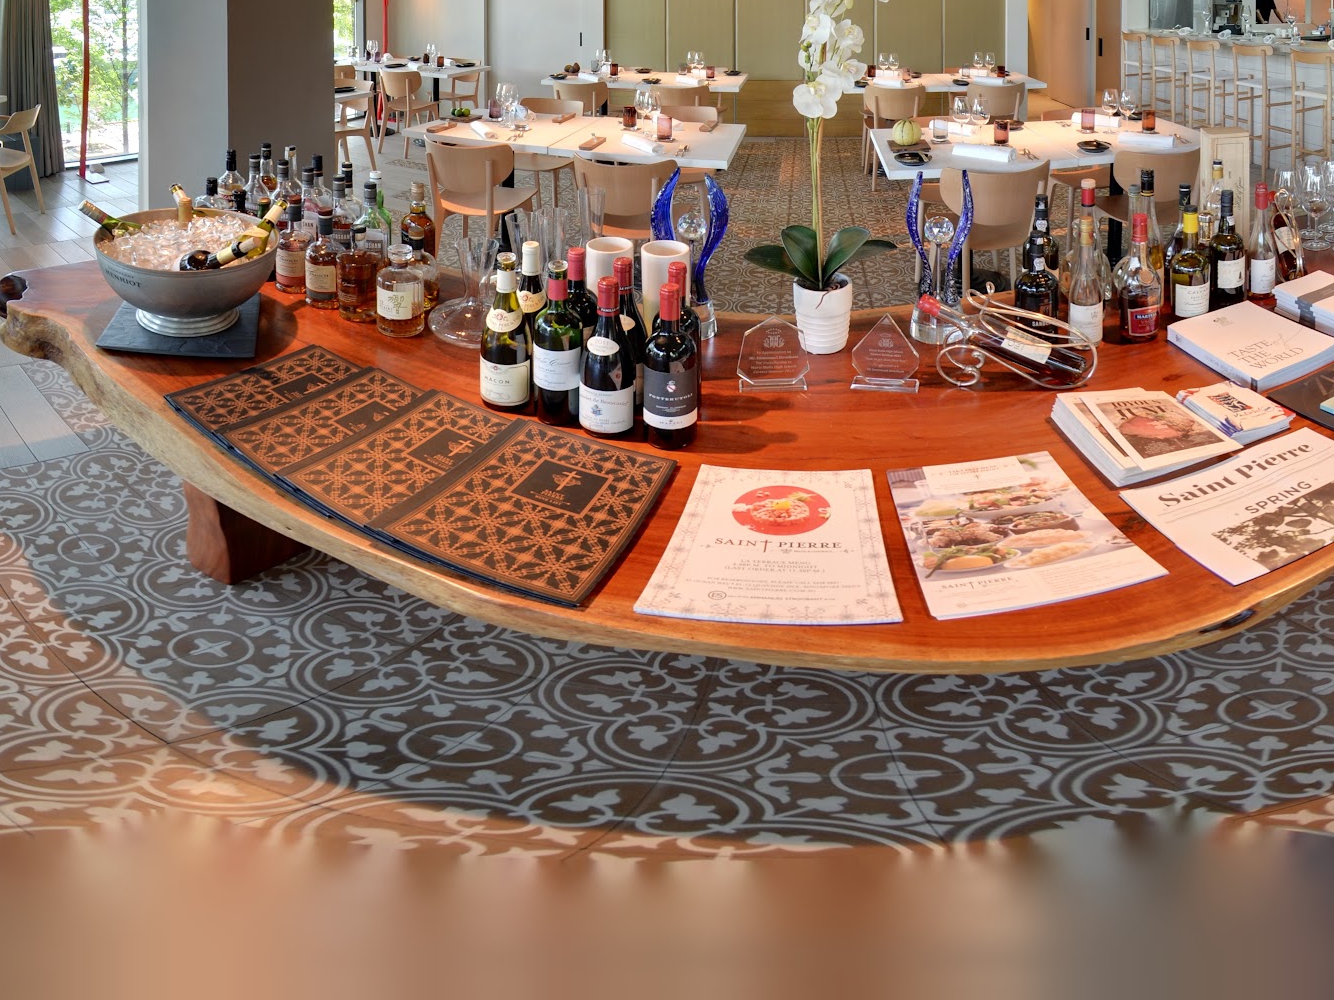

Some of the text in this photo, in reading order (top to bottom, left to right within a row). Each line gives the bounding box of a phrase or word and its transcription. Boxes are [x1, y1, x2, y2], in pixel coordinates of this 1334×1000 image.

[105, 268, 143, 288] HENRIOT
[1227, 340, 1273, 358] TASTE
[1238, 351, 1272, 364] THE
[1249, 347, 1304, 369] WORLD
[1158, 443, 1315, 508] Saint Pierre
[1244, 480, 1313, 515] SPRING
[714, 537, 842, 553] SAINT PIERRE
[978, 576, 1012, 585] PIERRE
